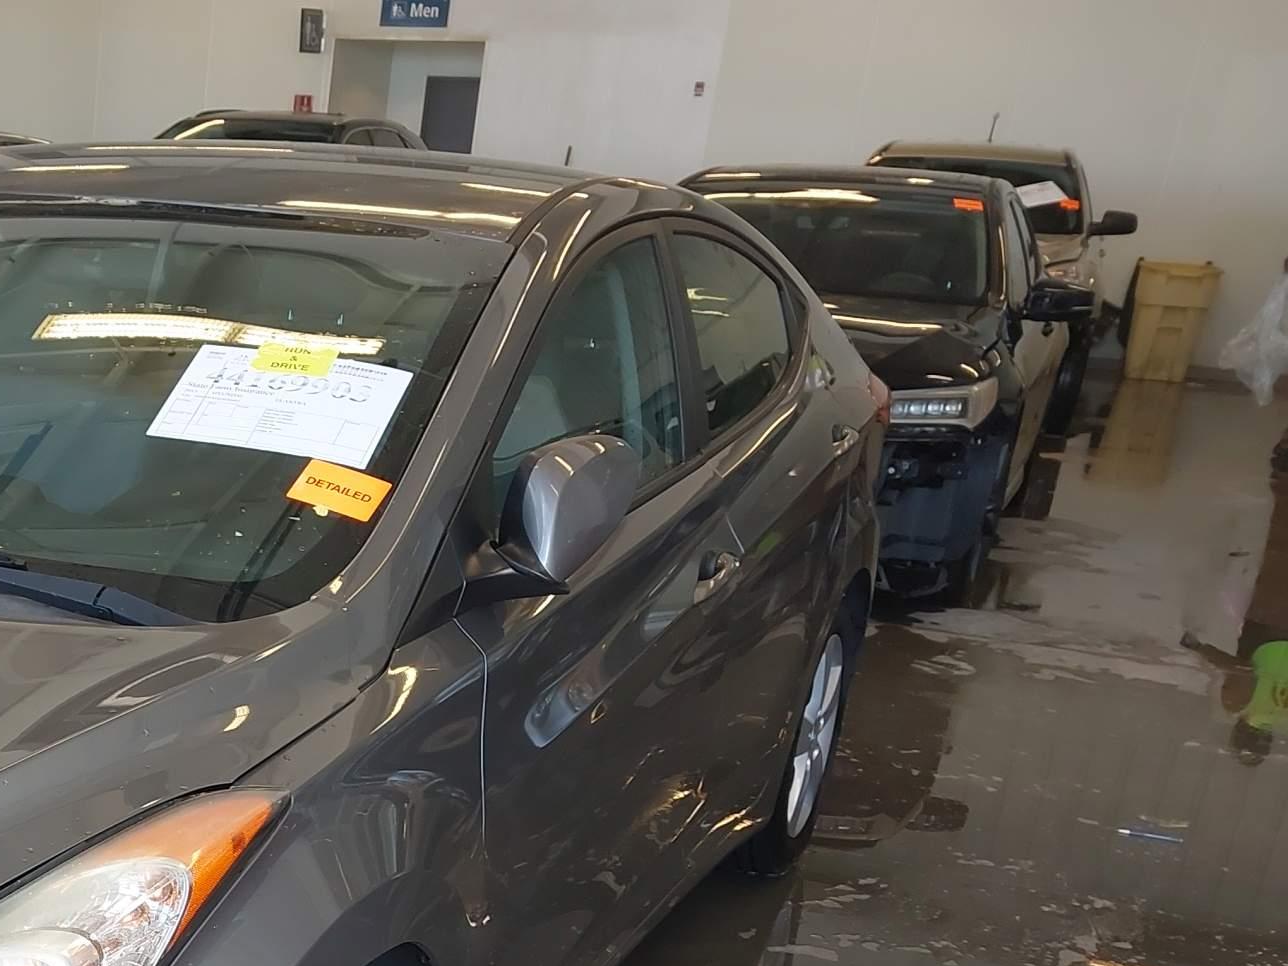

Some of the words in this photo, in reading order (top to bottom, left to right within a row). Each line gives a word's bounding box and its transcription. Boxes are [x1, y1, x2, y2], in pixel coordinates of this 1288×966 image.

[410, 2, 440, 18] Men
[270, 361, 311, 372] DRIVE
[305, 476, 372, 503] DETAILED
